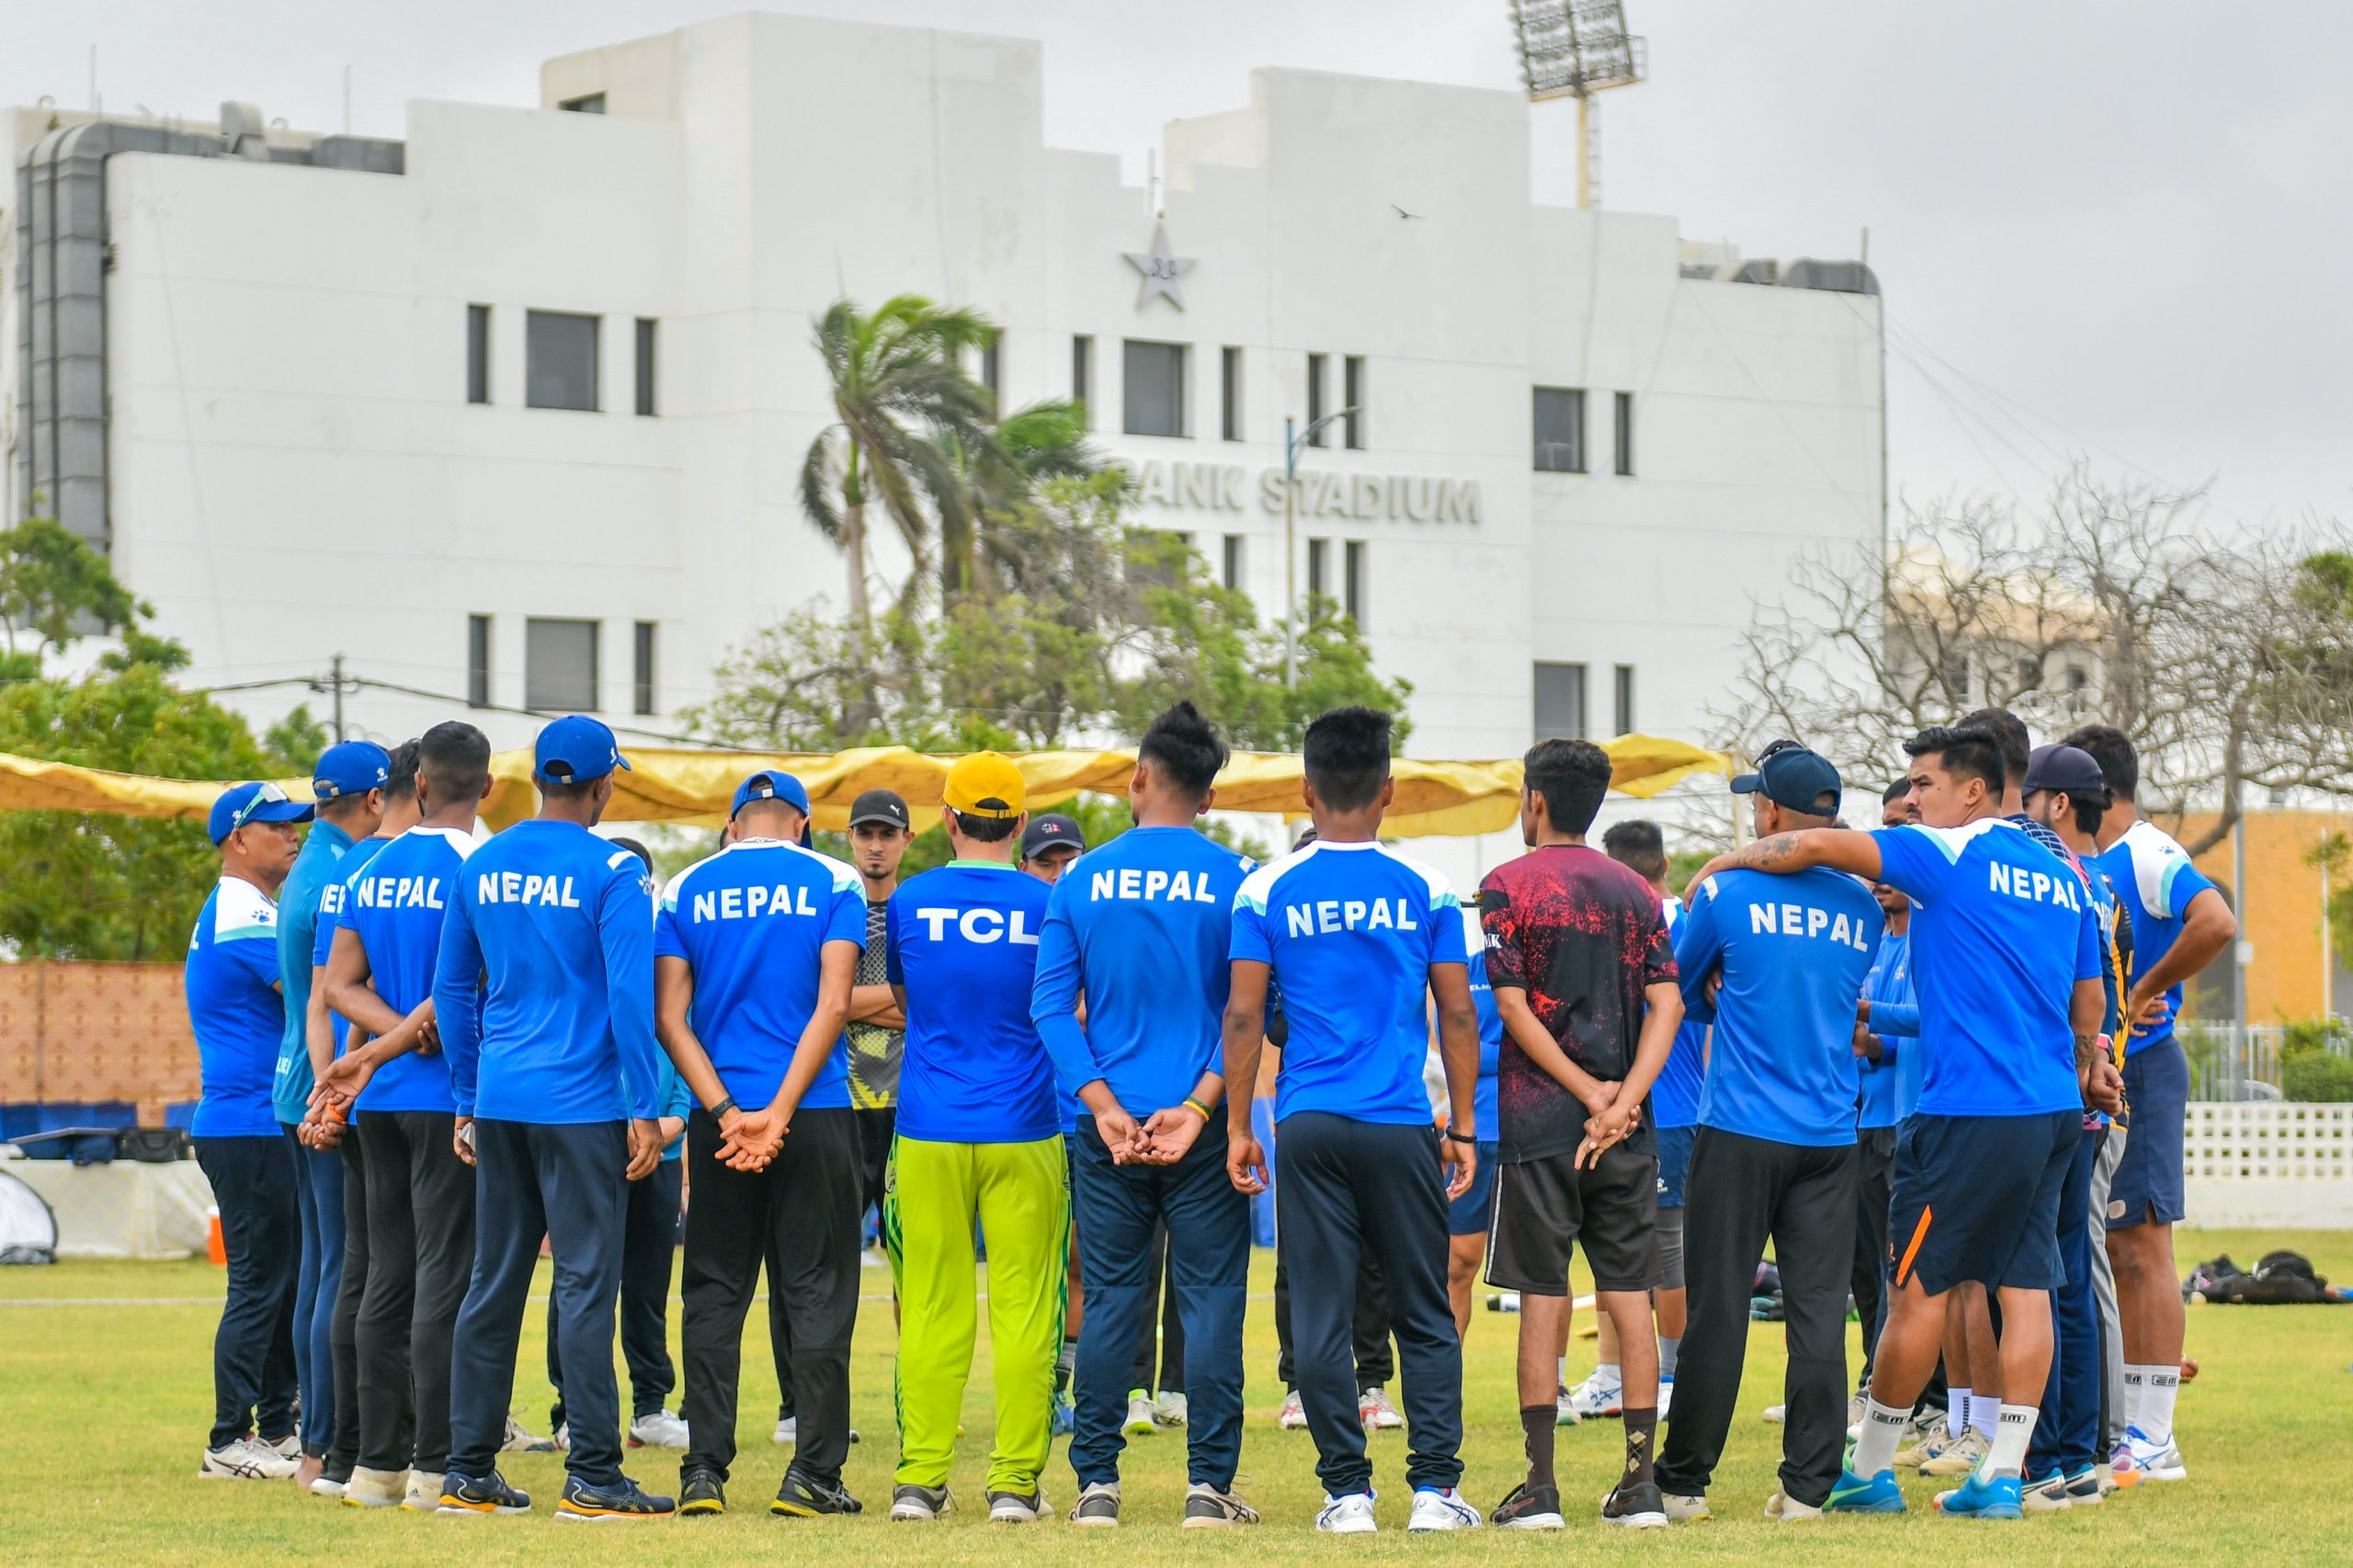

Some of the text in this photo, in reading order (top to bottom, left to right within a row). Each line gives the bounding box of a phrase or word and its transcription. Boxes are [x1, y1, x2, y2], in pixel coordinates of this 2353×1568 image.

[1112, 458, 1482, 525] ANK STADIUM
[358, 876, 443, 910] NEPAL
[478, 871, 580, 908] NEPAL
[693, 884, 817, 924] NEPAL
[1091, 869, 1216, 903] NEPAL
[1990, 860, 2081, 914] NEPAL
[916, 907, 1040, 945] TCL
[1286, 897, 1417, 937] NEPAL
[1749, 903, 1869, 952] NEPAL
